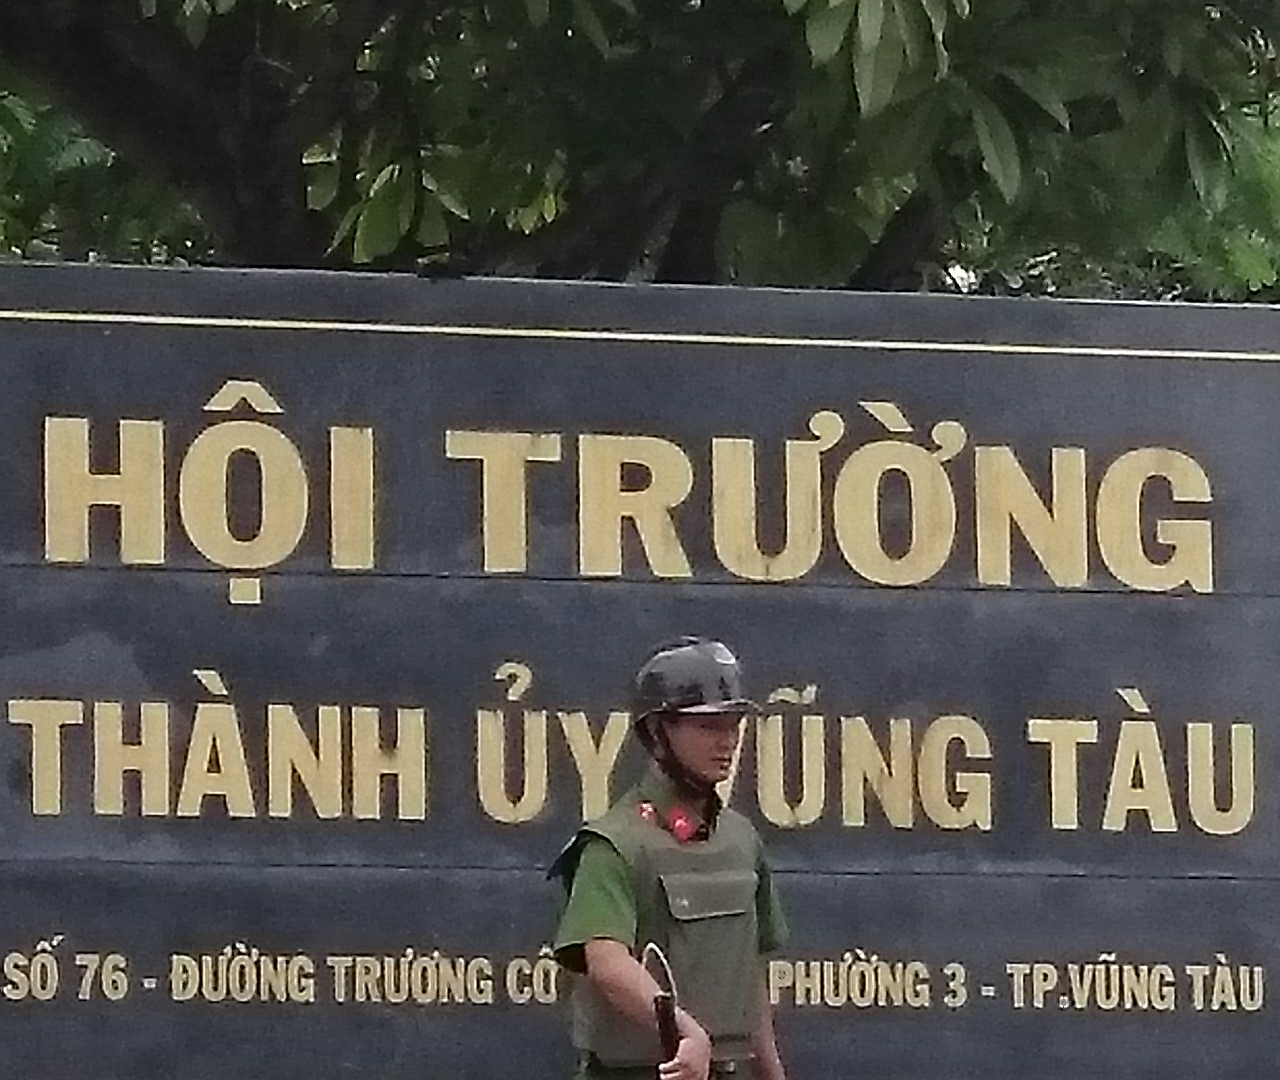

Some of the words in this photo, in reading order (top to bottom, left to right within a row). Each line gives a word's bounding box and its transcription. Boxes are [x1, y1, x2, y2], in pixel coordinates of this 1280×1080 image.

[44, 380, 375, 604] HỘI
[445, 402, 1214, 592] TRƯỜNG
[8, 669, 427, 820] THÀNH
[476, 663, 631, 823] ỦY
[1027, 688, 1256, 836] TÀU
[3, 933, 64, 1001] SỐ
[75, 953, 128, 1001] 76
[170, 940, 315, 1003] ĐƯỜNG
[326, 946, 494, 1004] TRƯƠNG
[769, 948, 931, 1008] PHƯỜNG
[943, 963, 968, 1008] 3
[1185, 952, 1264, 1011] TÀU
